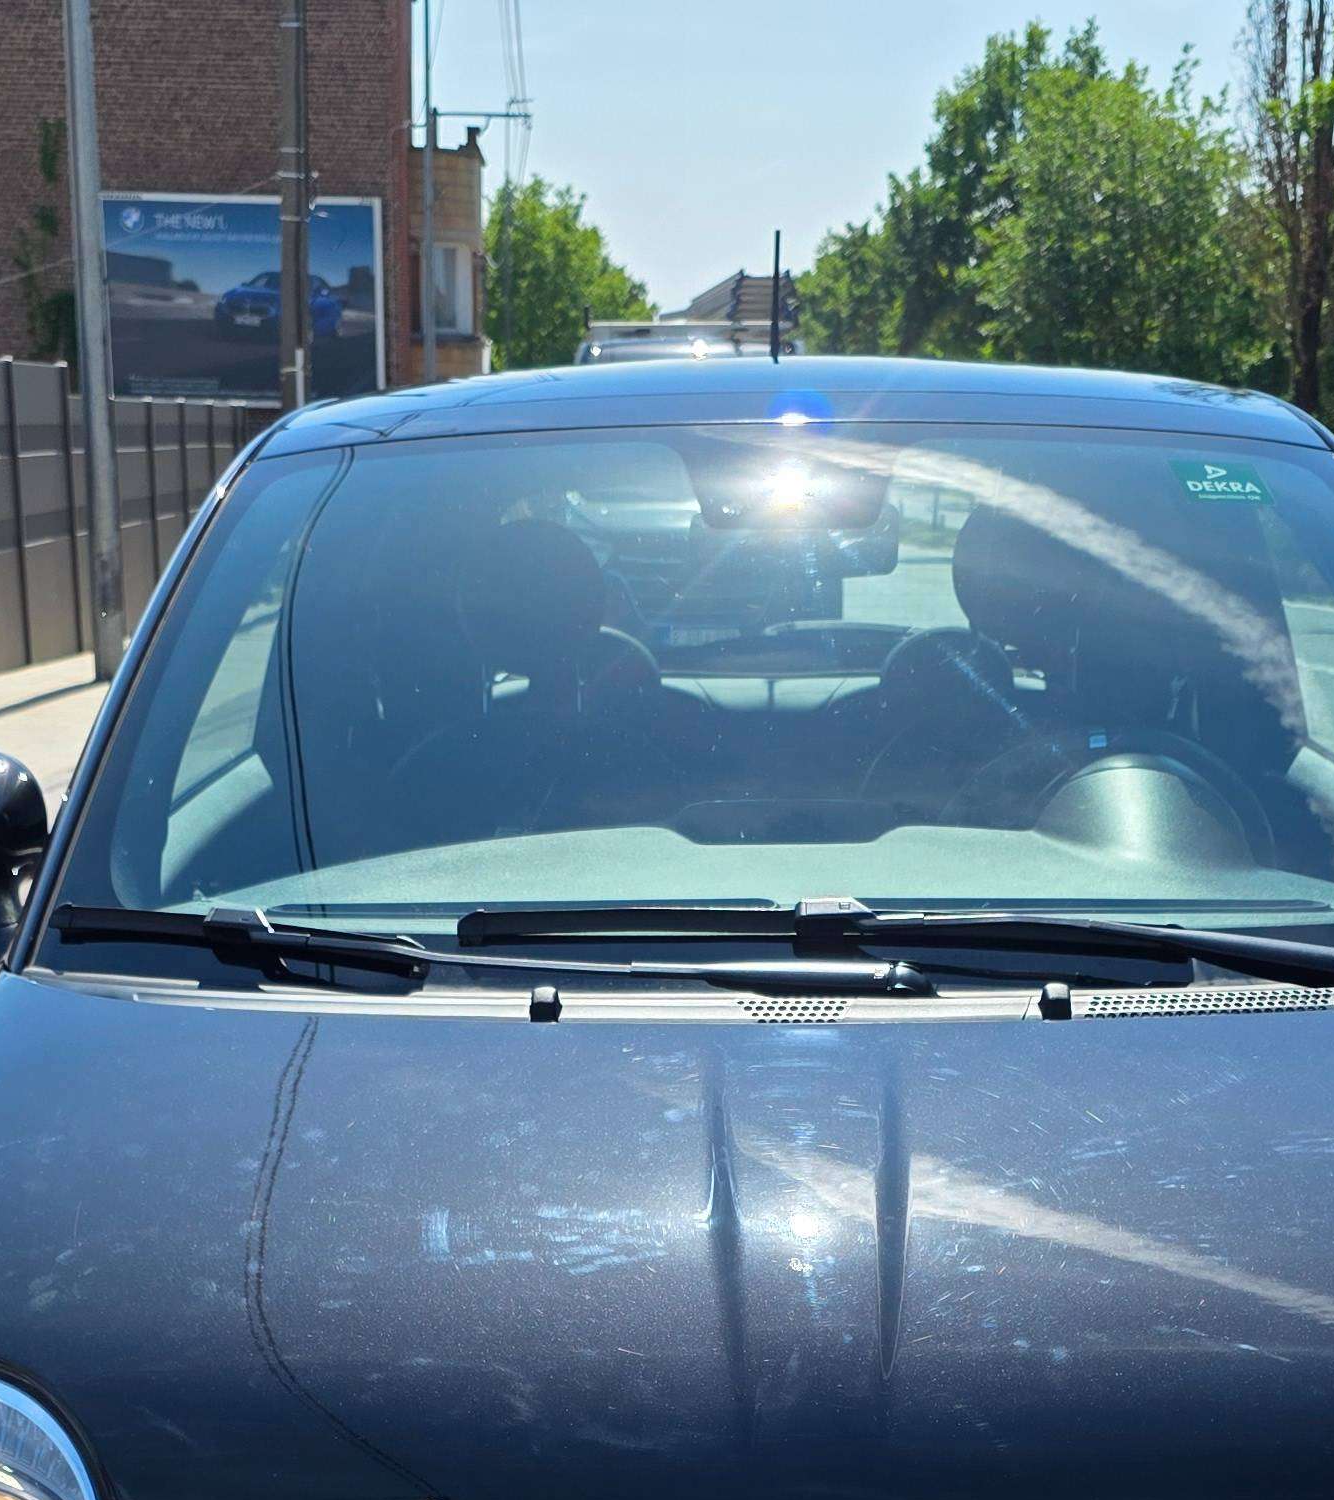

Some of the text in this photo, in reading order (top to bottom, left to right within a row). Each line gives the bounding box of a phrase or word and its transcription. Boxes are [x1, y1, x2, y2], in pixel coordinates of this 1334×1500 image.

[154, 213, 181, 229] THE
[183, 214, 215, 230] NEW
[1186, 480, 1261, 493] DEKRA
